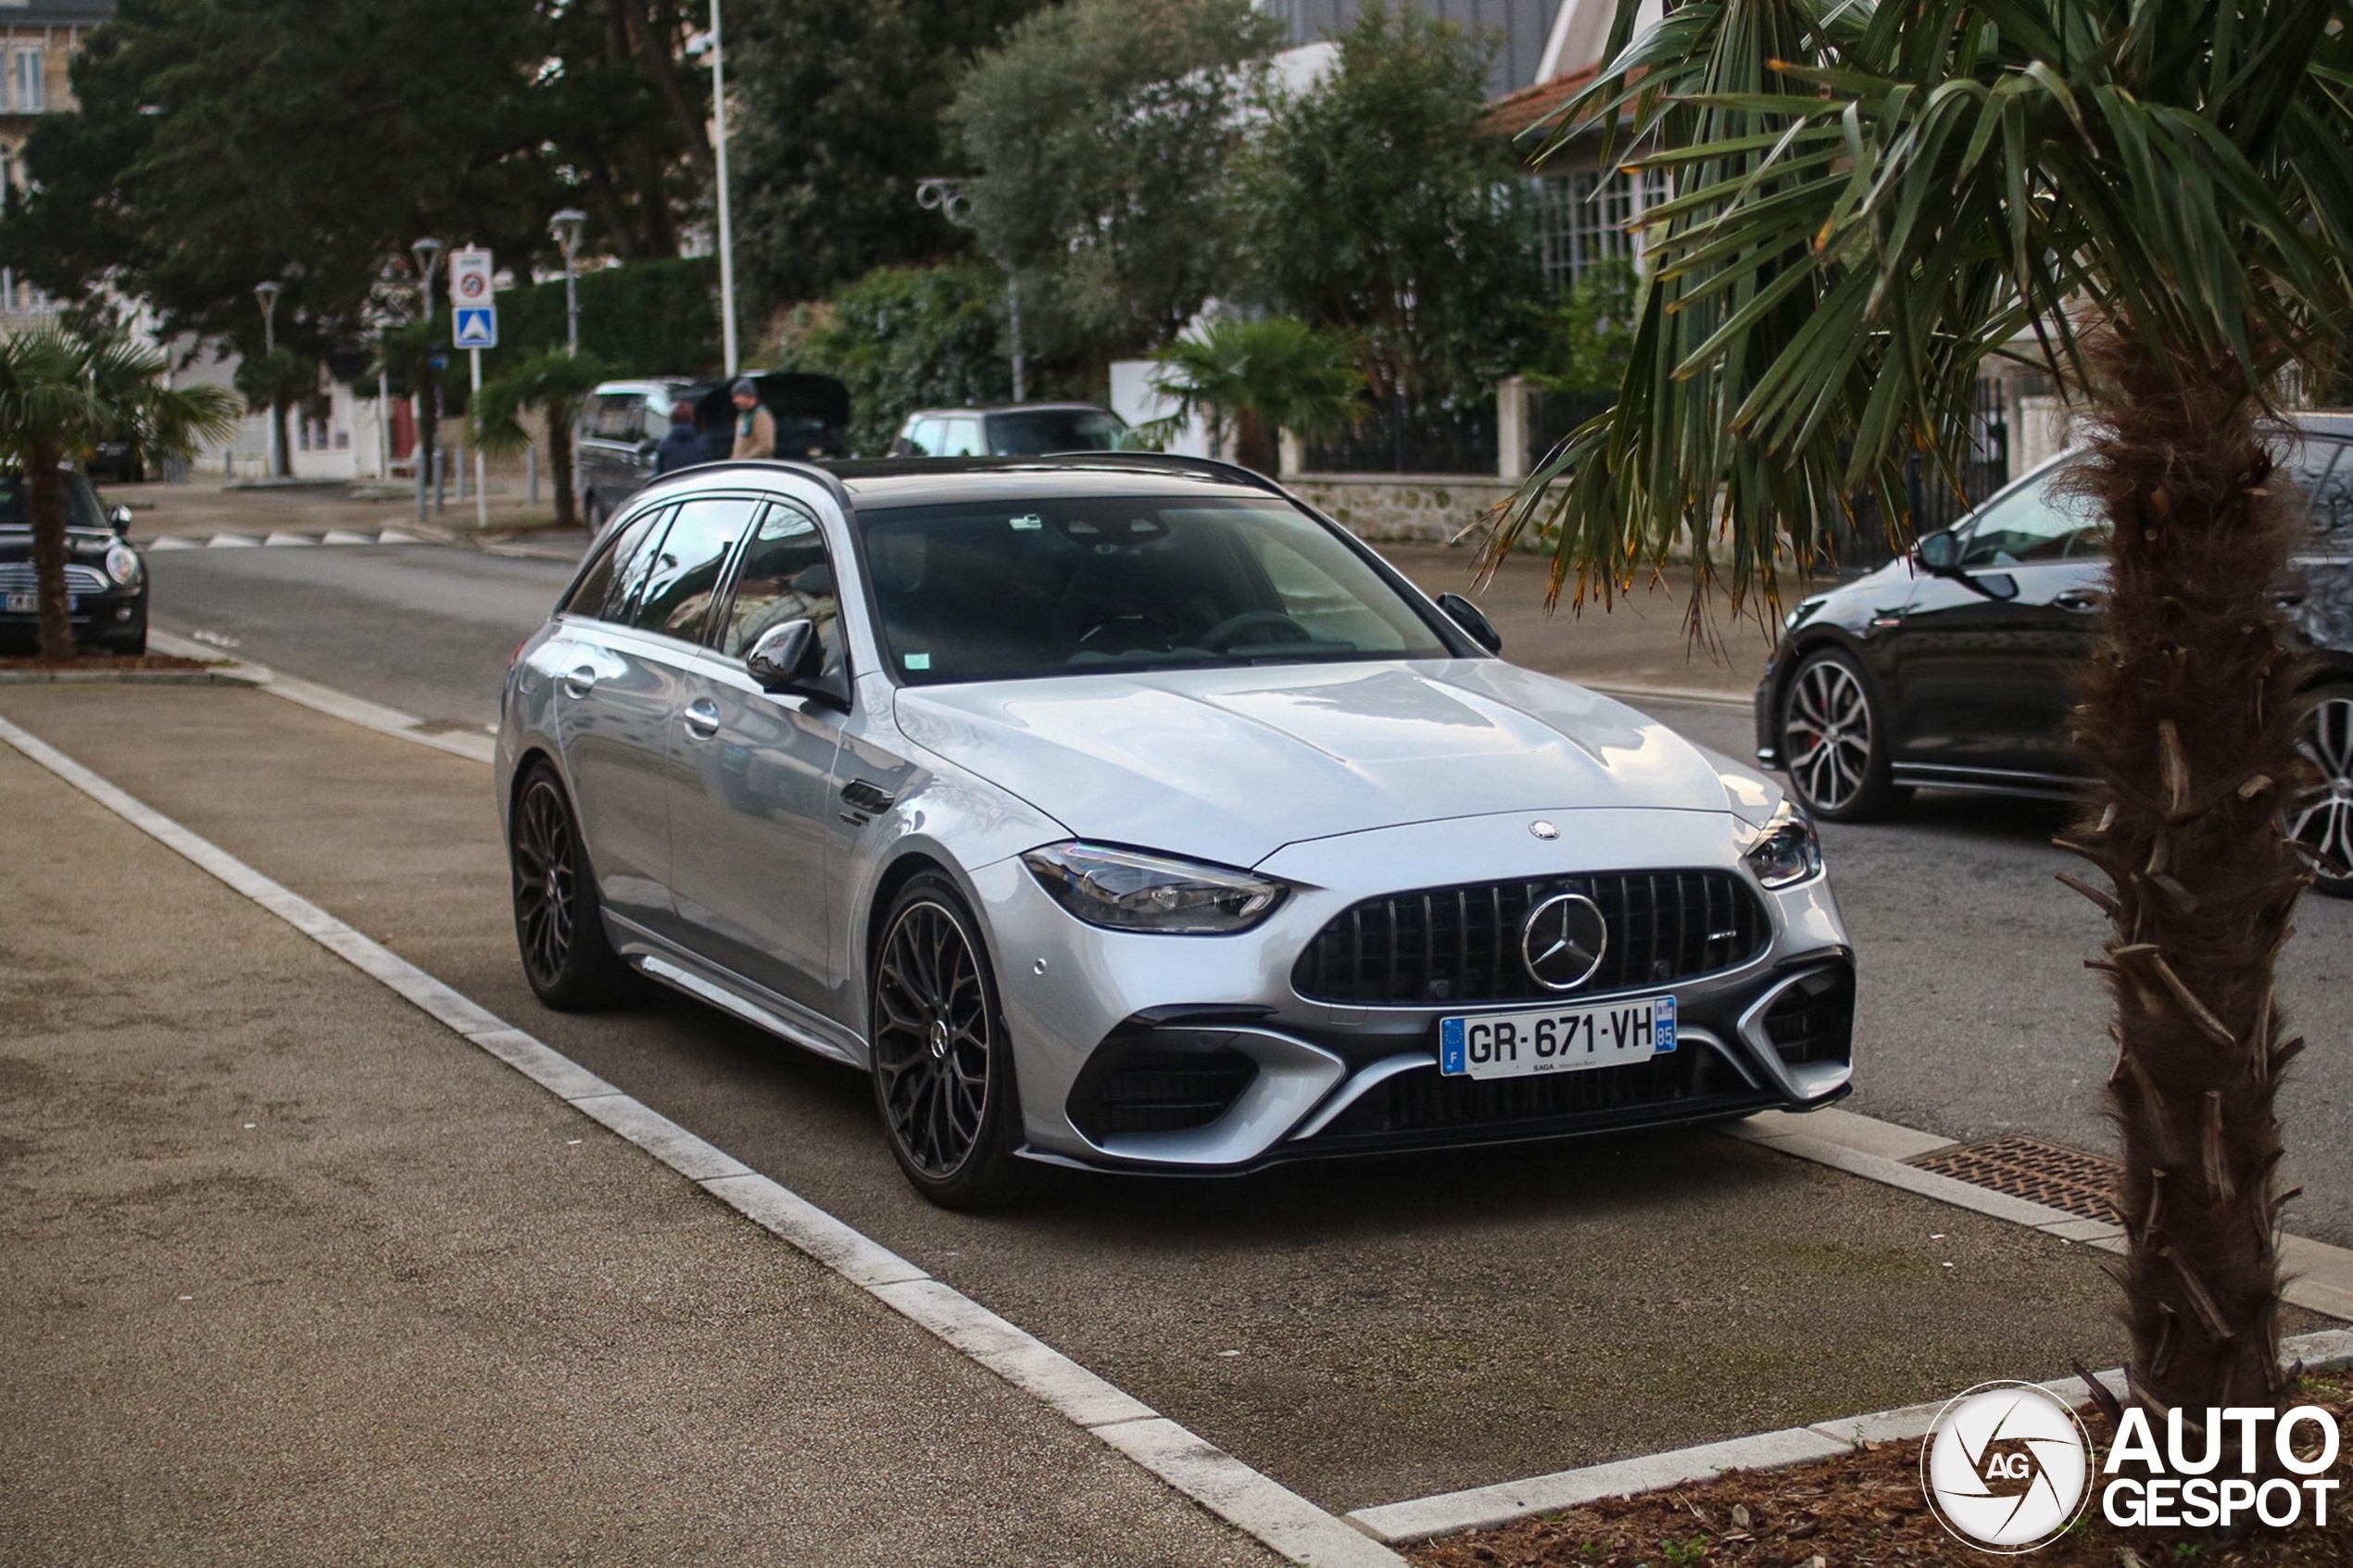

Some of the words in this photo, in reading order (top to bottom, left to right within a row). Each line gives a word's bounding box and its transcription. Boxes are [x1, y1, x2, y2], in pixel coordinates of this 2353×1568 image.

[1468, 1006, 1652, 1064] GR-671-VH
[1657, 1026, 1673, 1046] 85
[1450, 1051, 1458, 1064] F
[1533, 1063, 1554, 1072] SAGA
